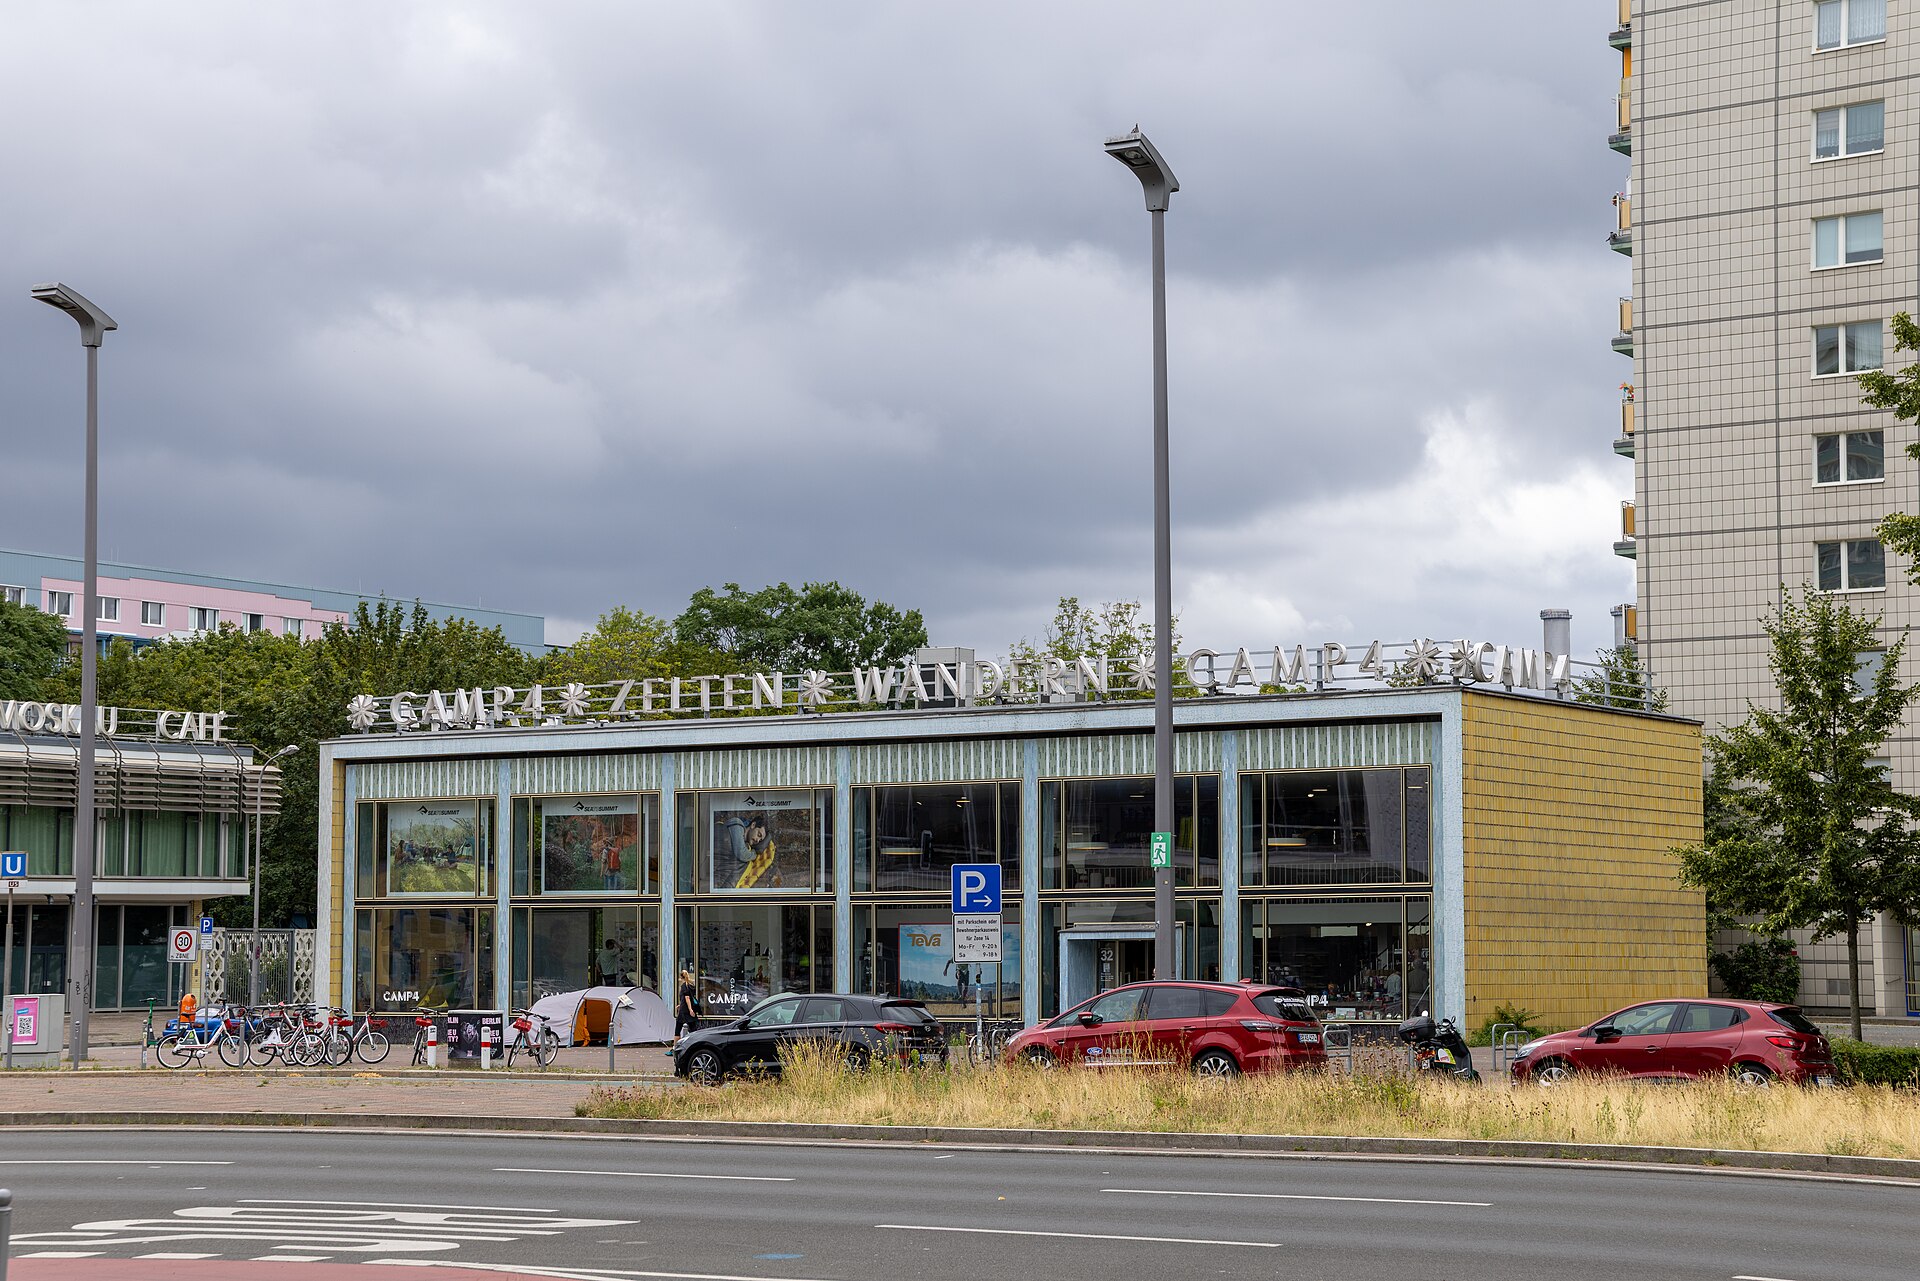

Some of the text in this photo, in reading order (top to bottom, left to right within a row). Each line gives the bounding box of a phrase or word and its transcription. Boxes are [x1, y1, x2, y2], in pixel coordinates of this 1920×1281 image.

[1186, 639, 1386, 689] CAMP4
[852, 653, 1108, 704] WANDERN
[390, 683, 543, 725] CAMP4
[609, 671, 783, 716] ZELTEN
[0, 699, 118, 736] MOSKU
[6, 856, 22, 875] U
[960, 870, 986, 907] P
[202, 919, 211, 932] P
[178, 936, 190, 947] 30
[1100, 950, 1114, 961] 32
[383, 990, 420, 1002] CAMP4
[707, 992, 749, 1004] CAMP4
